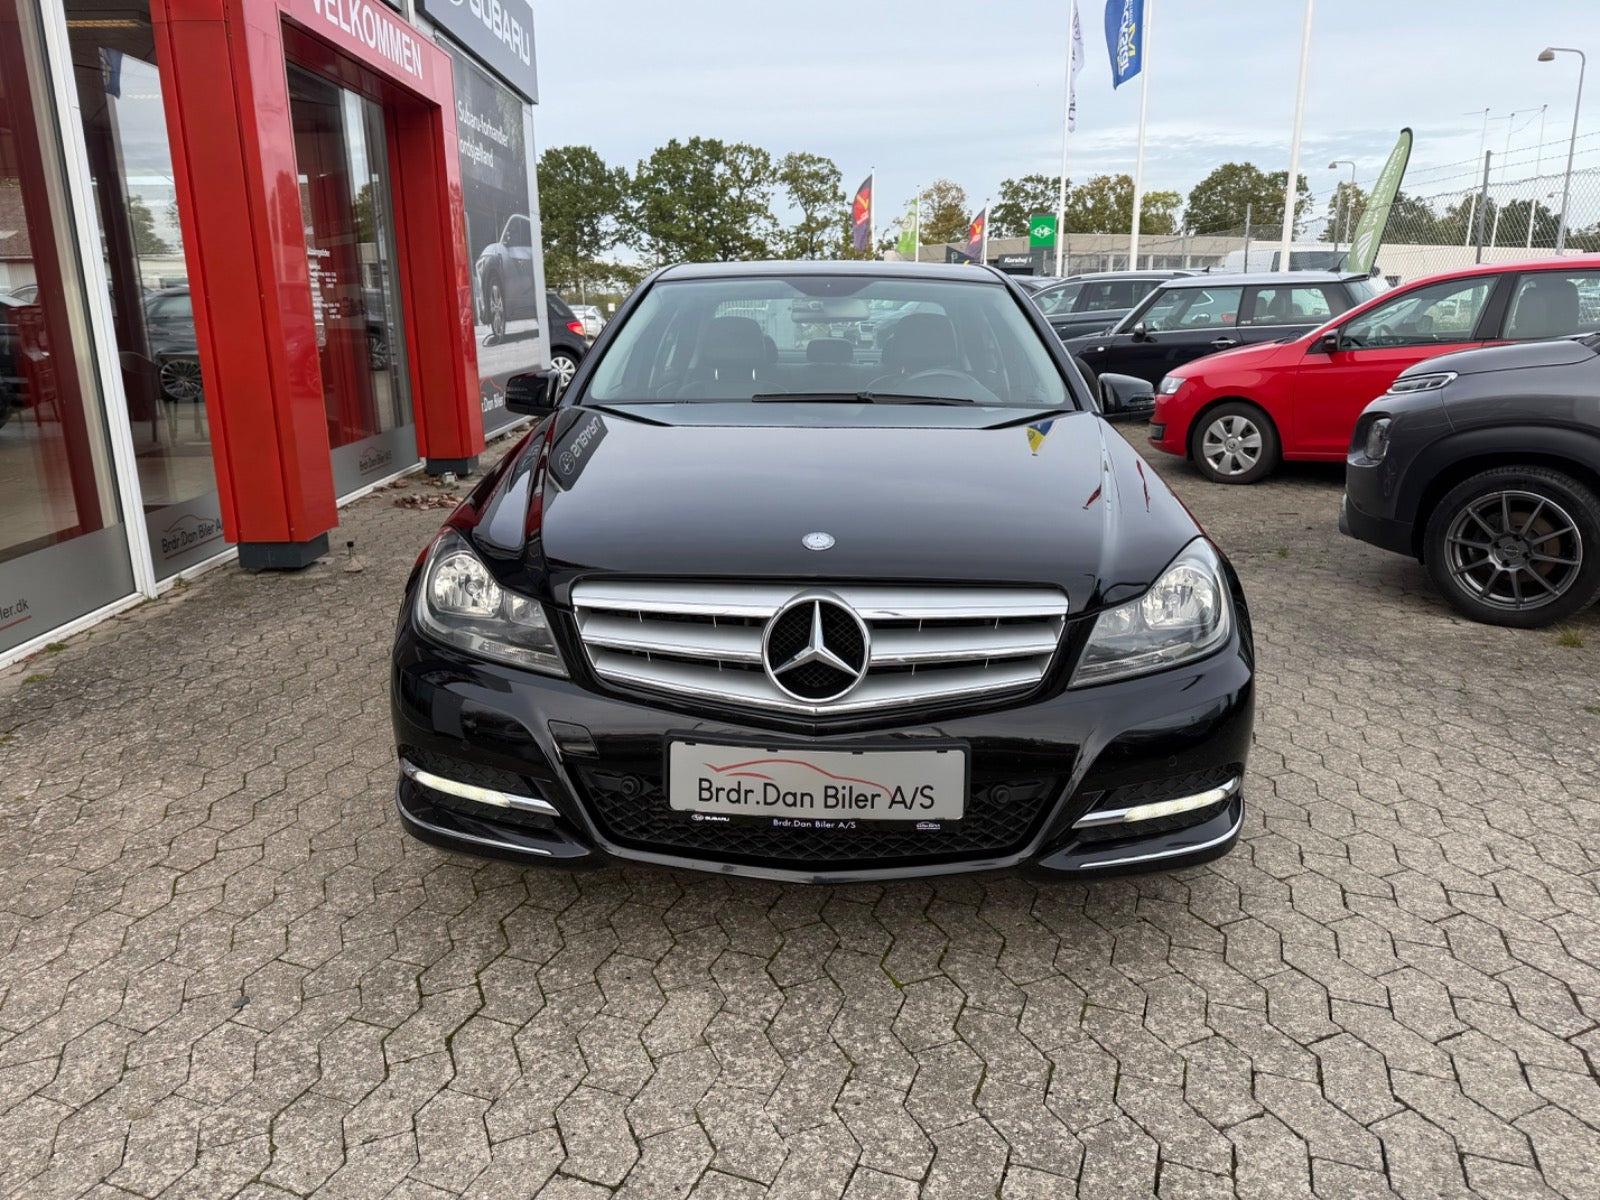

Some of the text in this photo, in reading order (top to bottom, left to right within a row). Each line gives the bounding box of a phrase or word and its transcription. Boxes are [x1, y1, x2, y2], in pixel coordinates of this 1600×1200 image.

[698, 777, 935, 811] Brdr.Dan Biler A/S
[772, 819, 857, 830] Brdr.Dan Biler A/S
